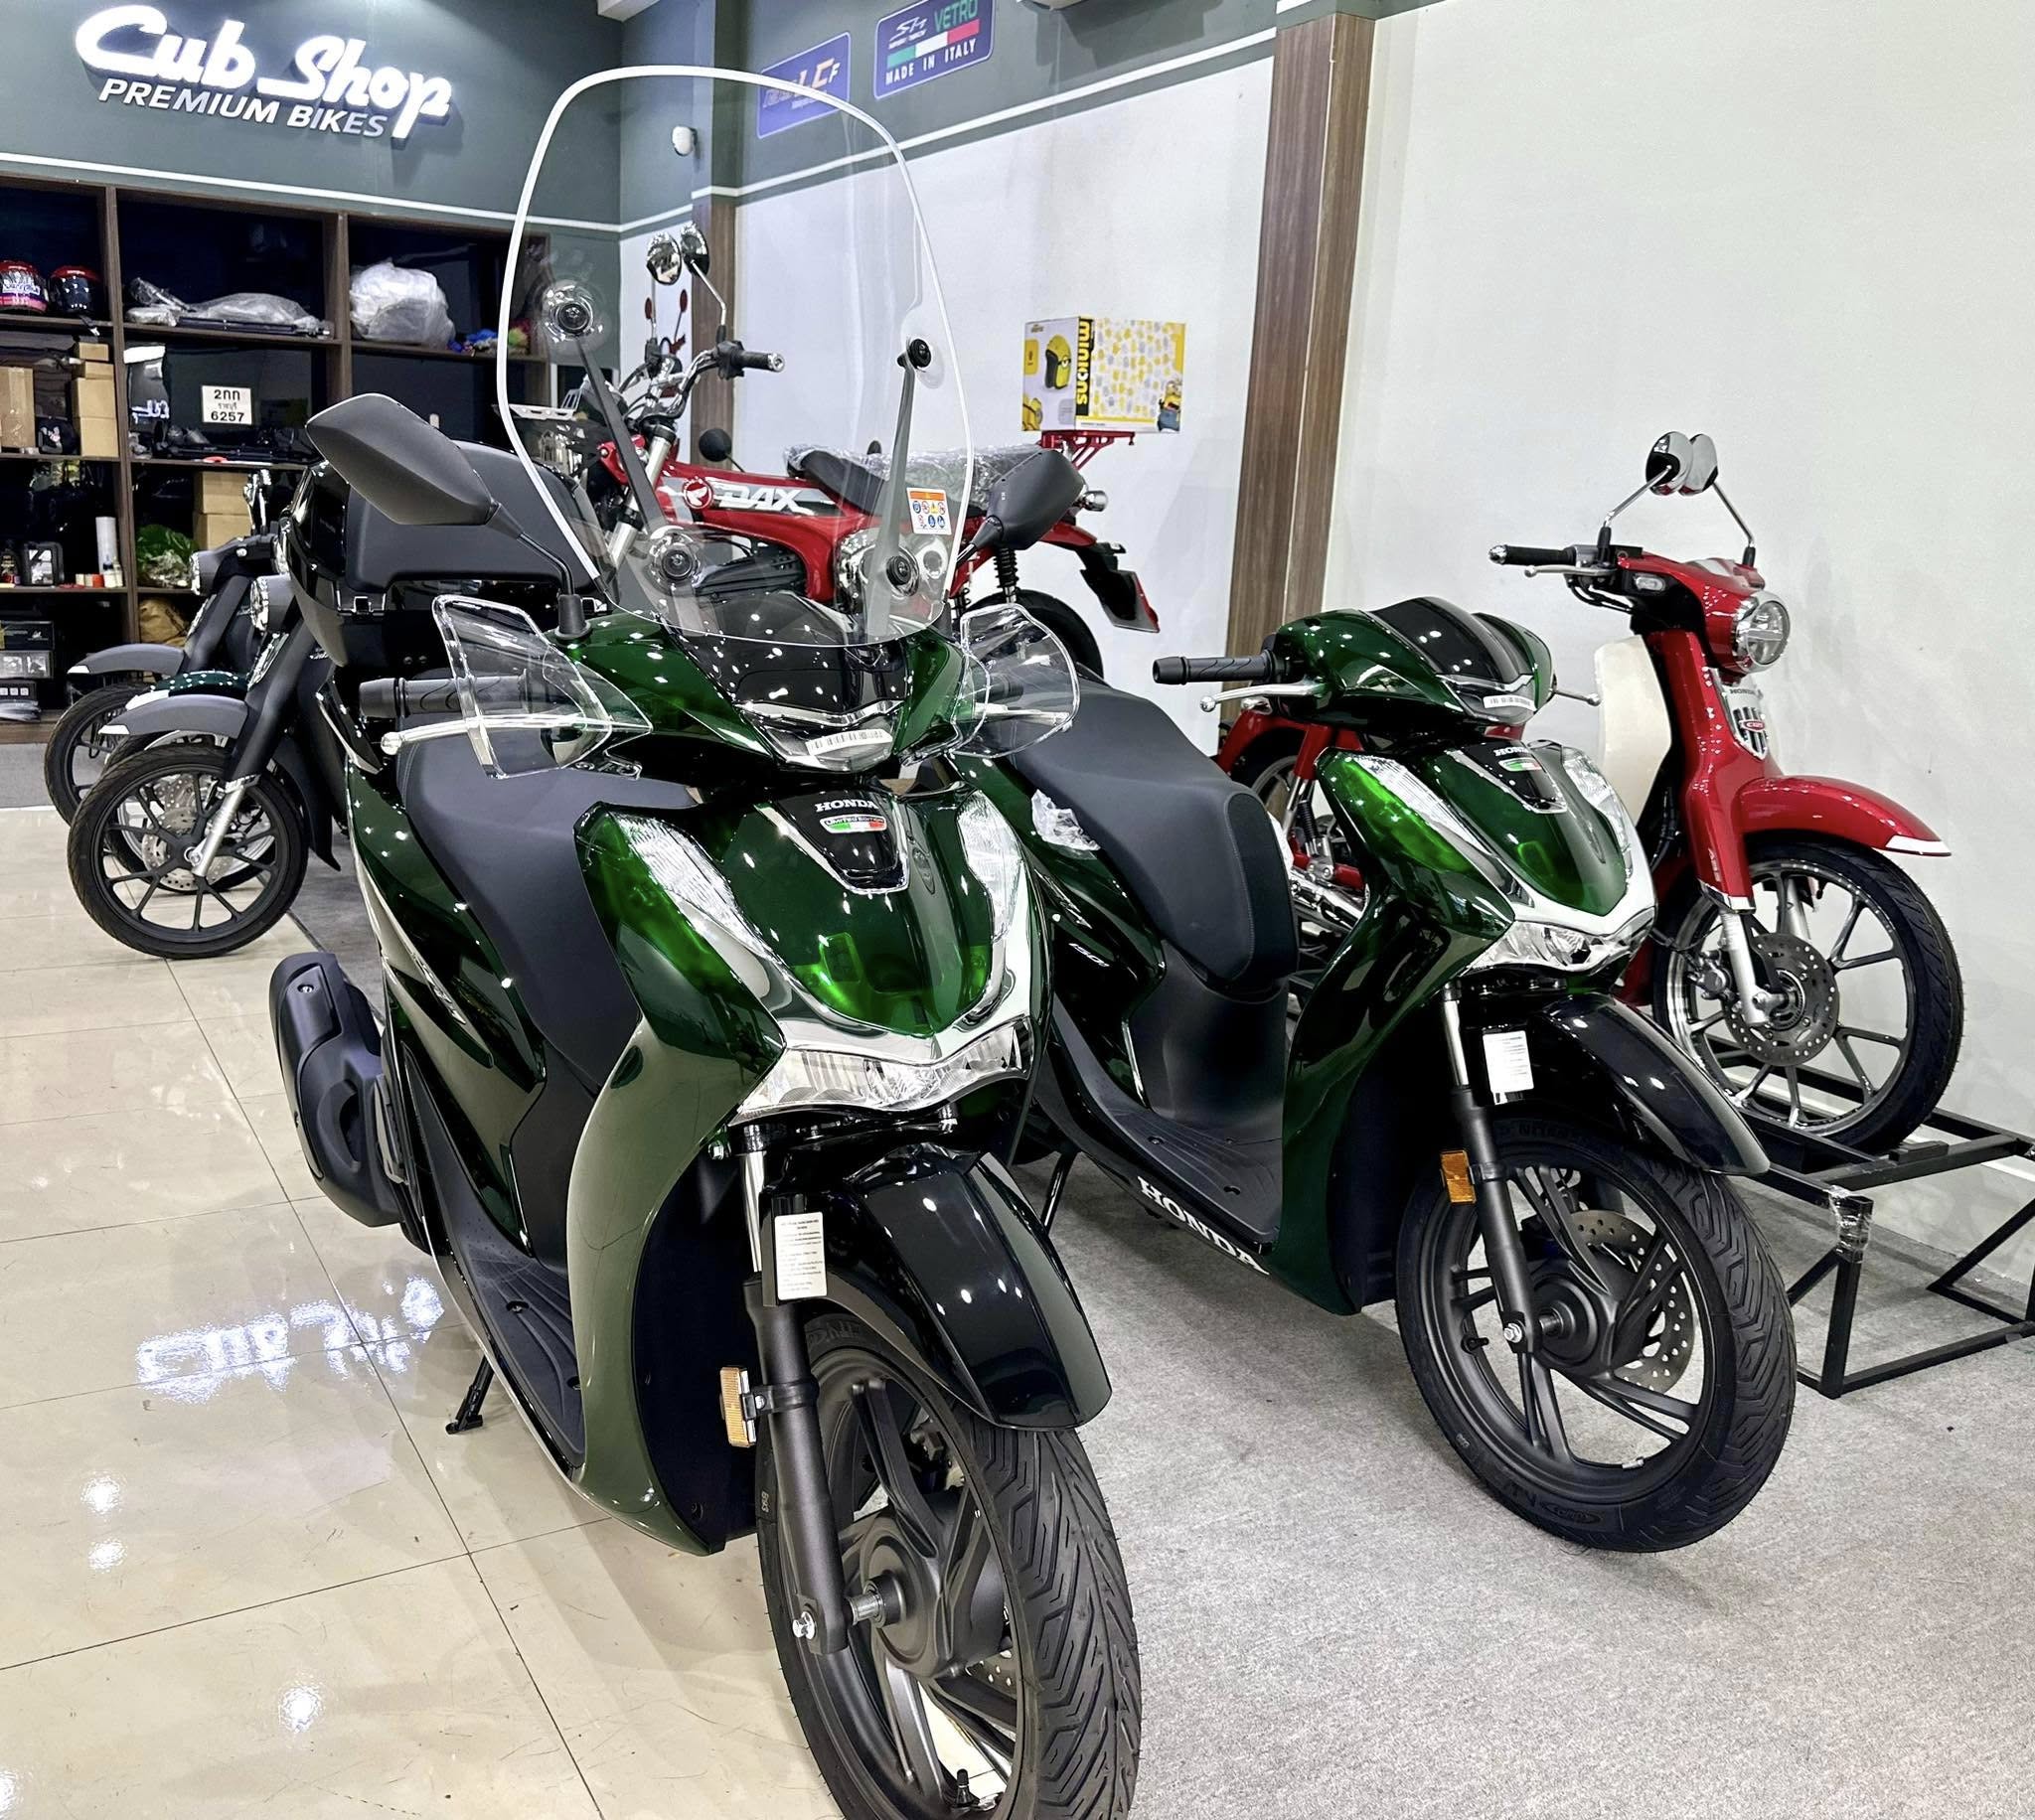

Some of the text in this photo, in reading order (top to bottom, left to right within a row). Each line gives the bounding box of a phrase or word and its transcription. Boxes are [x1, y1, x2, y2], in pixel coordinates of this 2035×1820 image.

[76, 5, 452, 138] Cub Shop
[885, 63, 914, 85] MADE
[923, 55, 935, 72] IN
[945, 39, 976, 63] ITALY
[98, 78, 388, 138] PREMIUM BIKES
[214, 388, 240, 400] 2กก
[211, 410, 244, 422] 6257
[711, 484, 816, 516] DAX
[815, 799, 879, 813] HONDA
[1138, 1175, 1271, 1276] HONDA
